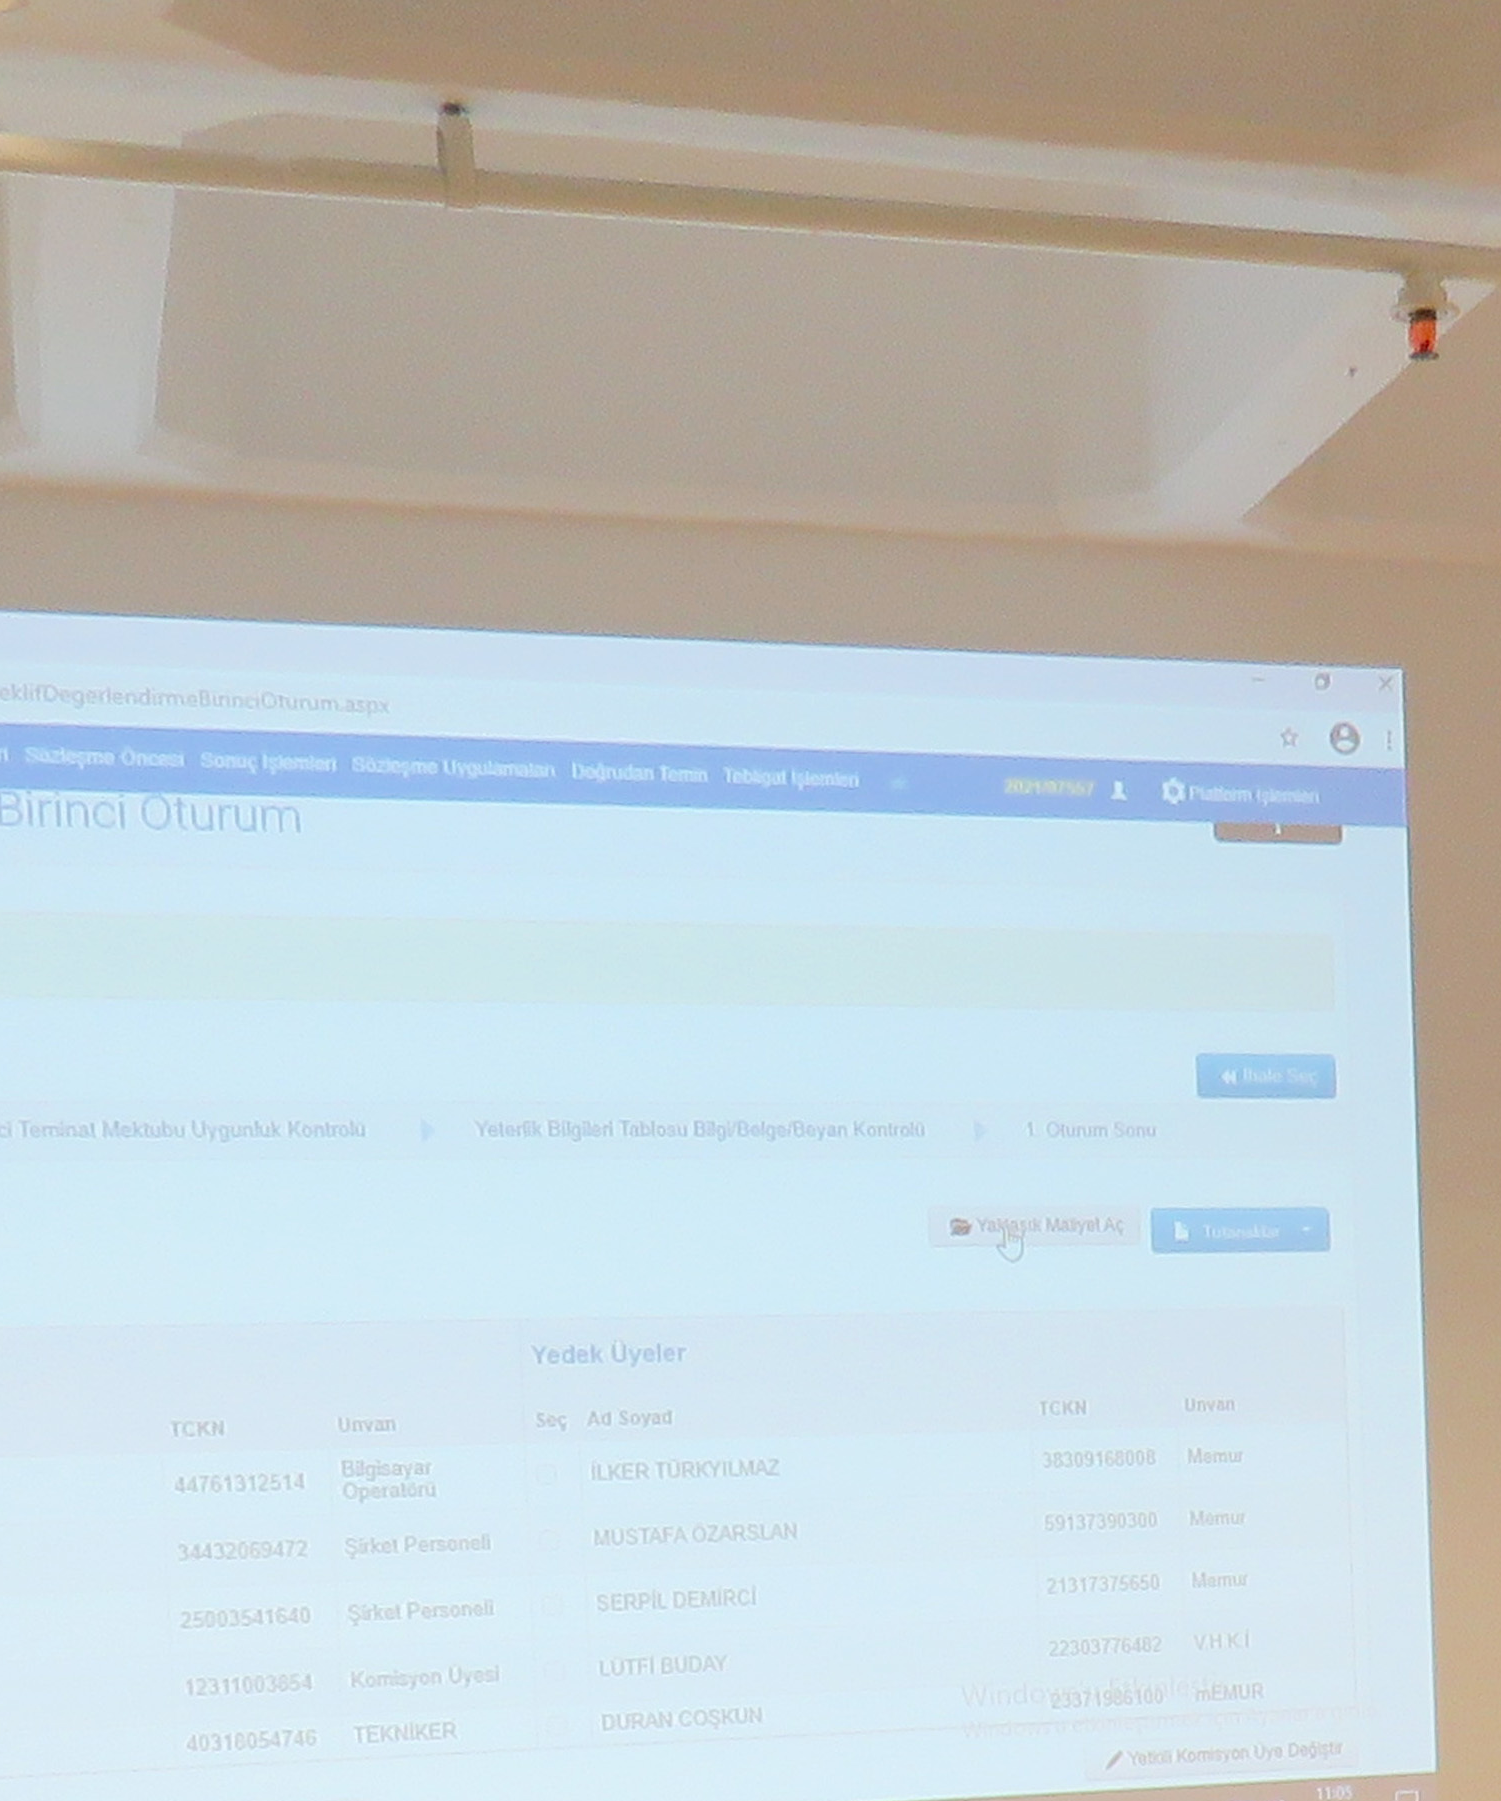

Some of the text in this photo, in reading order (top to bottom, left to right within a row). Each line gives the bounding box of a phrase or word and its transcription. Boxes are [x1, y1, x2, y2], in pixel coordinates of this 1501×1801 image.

[0, 790, 126, 828] Birinci
[141, 795, 303, 834] Oturum
[101, 1119, 186, 1140] Mektubu
[191, 1119, 281, 1143] Uygunluk
[619, 1120, 687, 1140] Tablosu
[1046, 1121, 1107, 1138] Oturum
[531, 1340, 687, 1367] Yedek Üyeler
[1039, 1399, 1088, 1416] TCKN
[1184, 1398, 1236, 1412] Unvan
[171, 1420, 225, 1437] TCKN
[337, 1418, 396, 1433] Unvan
[536, 1412, 567, 1430] Seç
[587, 1410, 672, 1429] Ad Soyad
[1043, 1449, 1156, 1469] 38309168008
[1187, 1449, 1243, 1465] Memur
[342, 1459, 432, 1479] Bilgisayar
[591, 1462, 650, 1481] İLKER
[175, 1473, 305, 1493] 44761312514
[1189, 1510, 1245, 1527] Memur
[594, 1525, 685, 1546] MUSTAFA
[345, 1534, 491, 1559] Şirket Personeli
[1047, 1574, 1160, 1595] 21317375650
[1192, 1572, 1248, 1589] Memur
[597, 1584, 757, 1612] SERPİL DEMİRCİ
[348, 1600, 494, 1626] Şirket Personeli
[661, 1654, 729, 1675] BUDAY
[351, 1669, 442, 1691] Komisyon
[1195, 1683, 1264, 1702] mEMUR
[602, 1706, 763, 1732] DURAN COŞKUN
[354, 1721, 457, 1744] TEKNİKER
[1177, 1745, 1249, 1764] Komisyon
